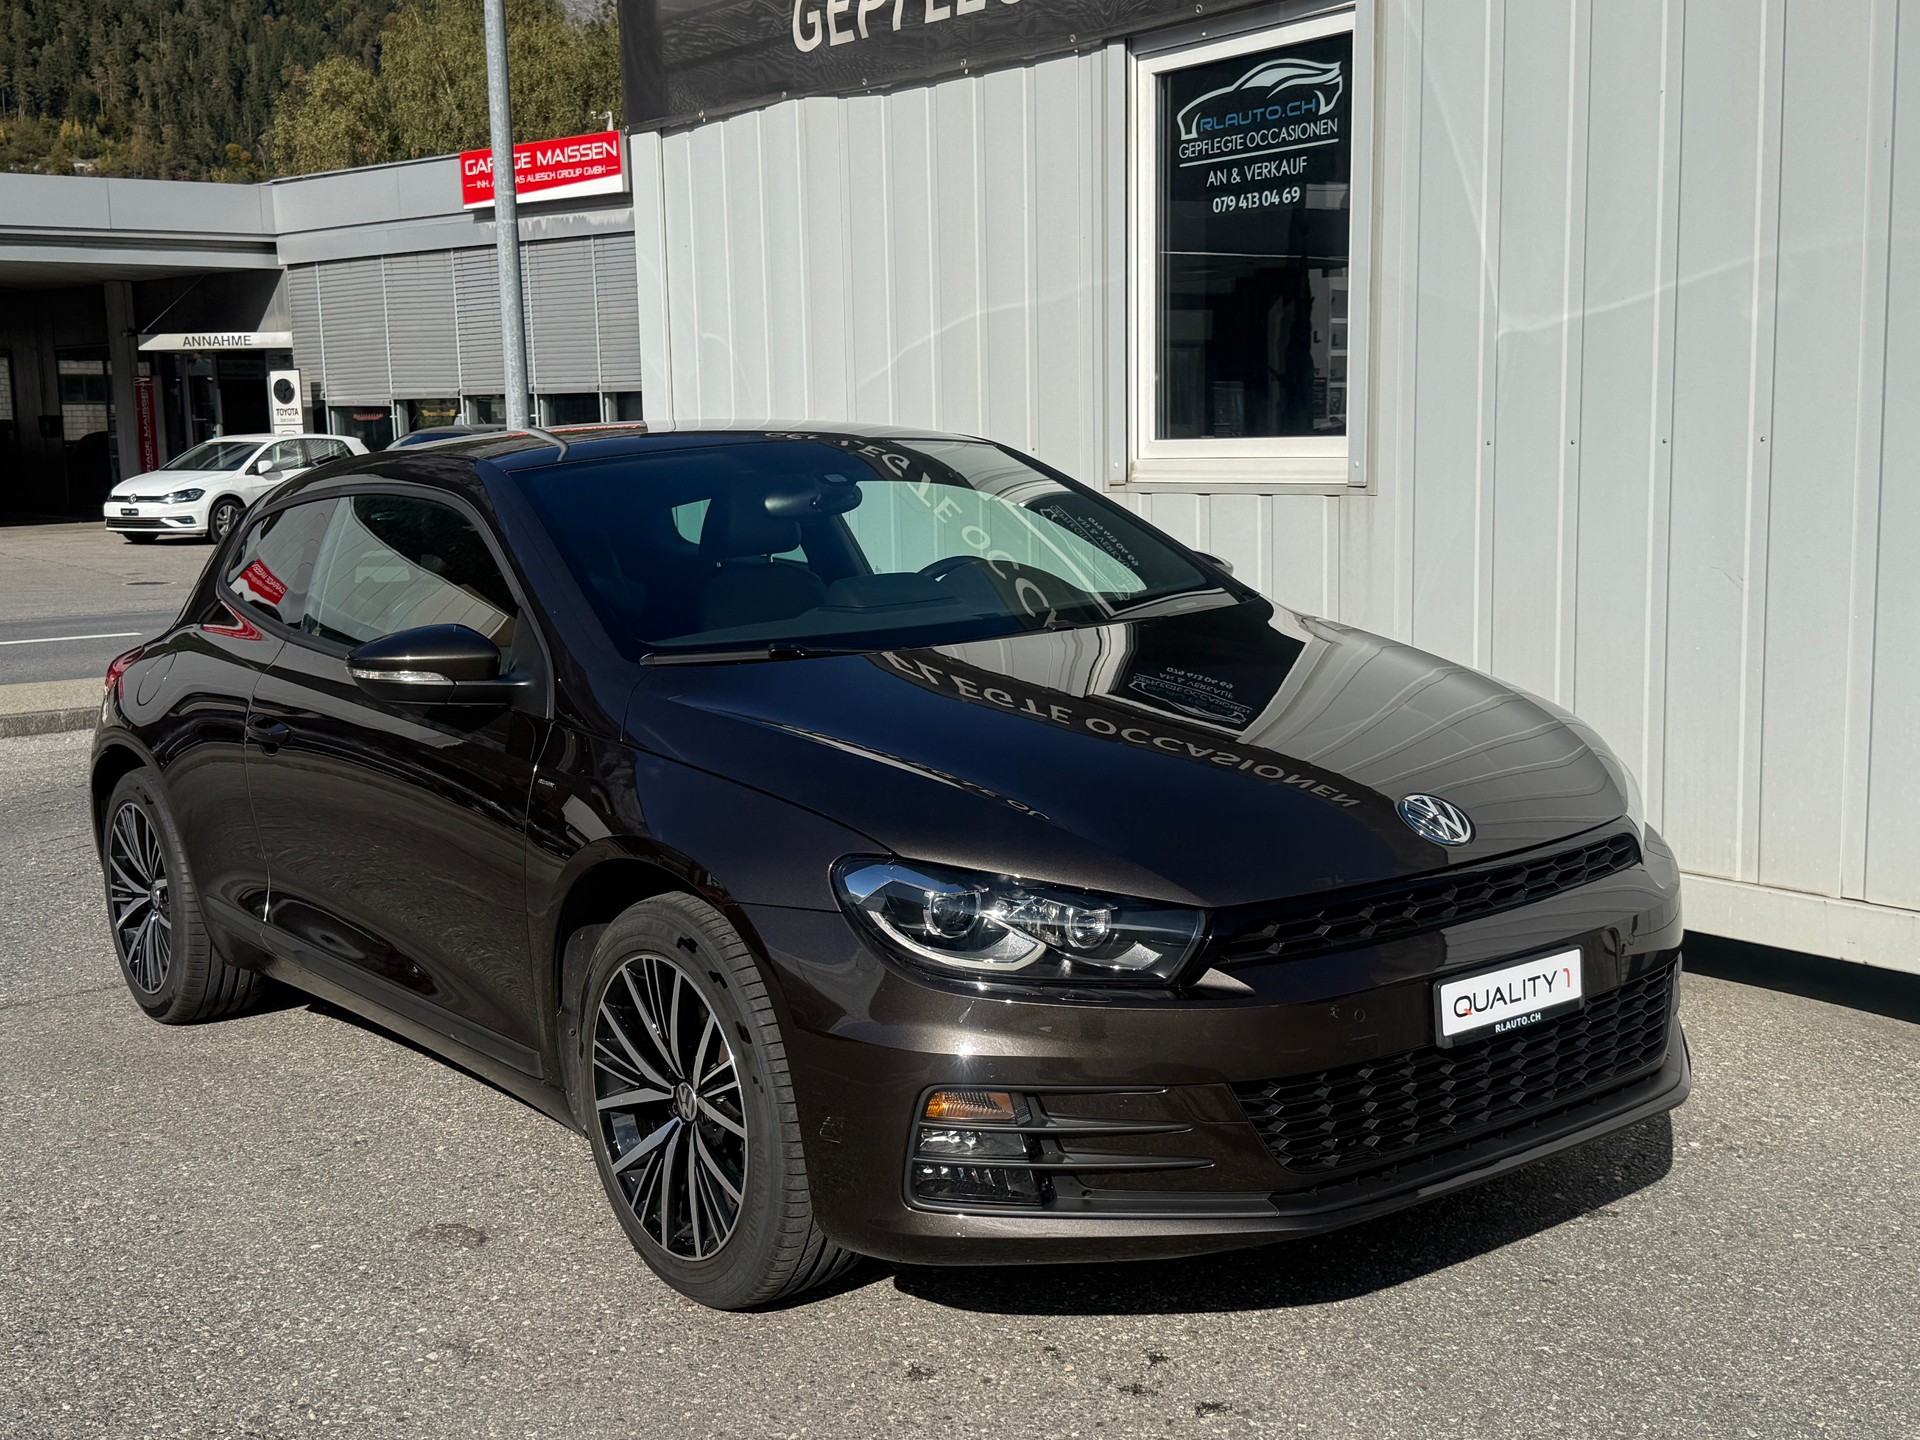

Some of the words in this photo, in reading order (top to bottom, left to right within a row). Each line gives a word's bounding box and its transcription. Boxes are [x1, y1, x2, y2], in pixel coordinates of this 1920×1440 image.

[1200, 98, 1317, 132] RLAUTO.CH
[1178, 134, 1244, 158] GEPFLEGTE
[1246, 118, 1338, 147] OCCASIONEN
[537, 140, 617, 167] MAISSEN
[557, 168, 582, 179] GROUP
[1206, 169, 1227, 187] AN
[1231, 167, 1241, 184] &
[1244, 156, 1308, 181] VERKAUF
[1212, 197, 1236, 213] 079
[1238, 192, 1260, 208] 413
[1261, 190, 1280, 206] 04
[1282, 186, 1300, 204] 69
[183, 335, 253, 347] ANNAHME
[276, 407, 299, 416] TOYOTA
[1453, 970, 1557, 1018] QUALITY
[1495, 1012, 1542, 1033] RLAUTO.CH
